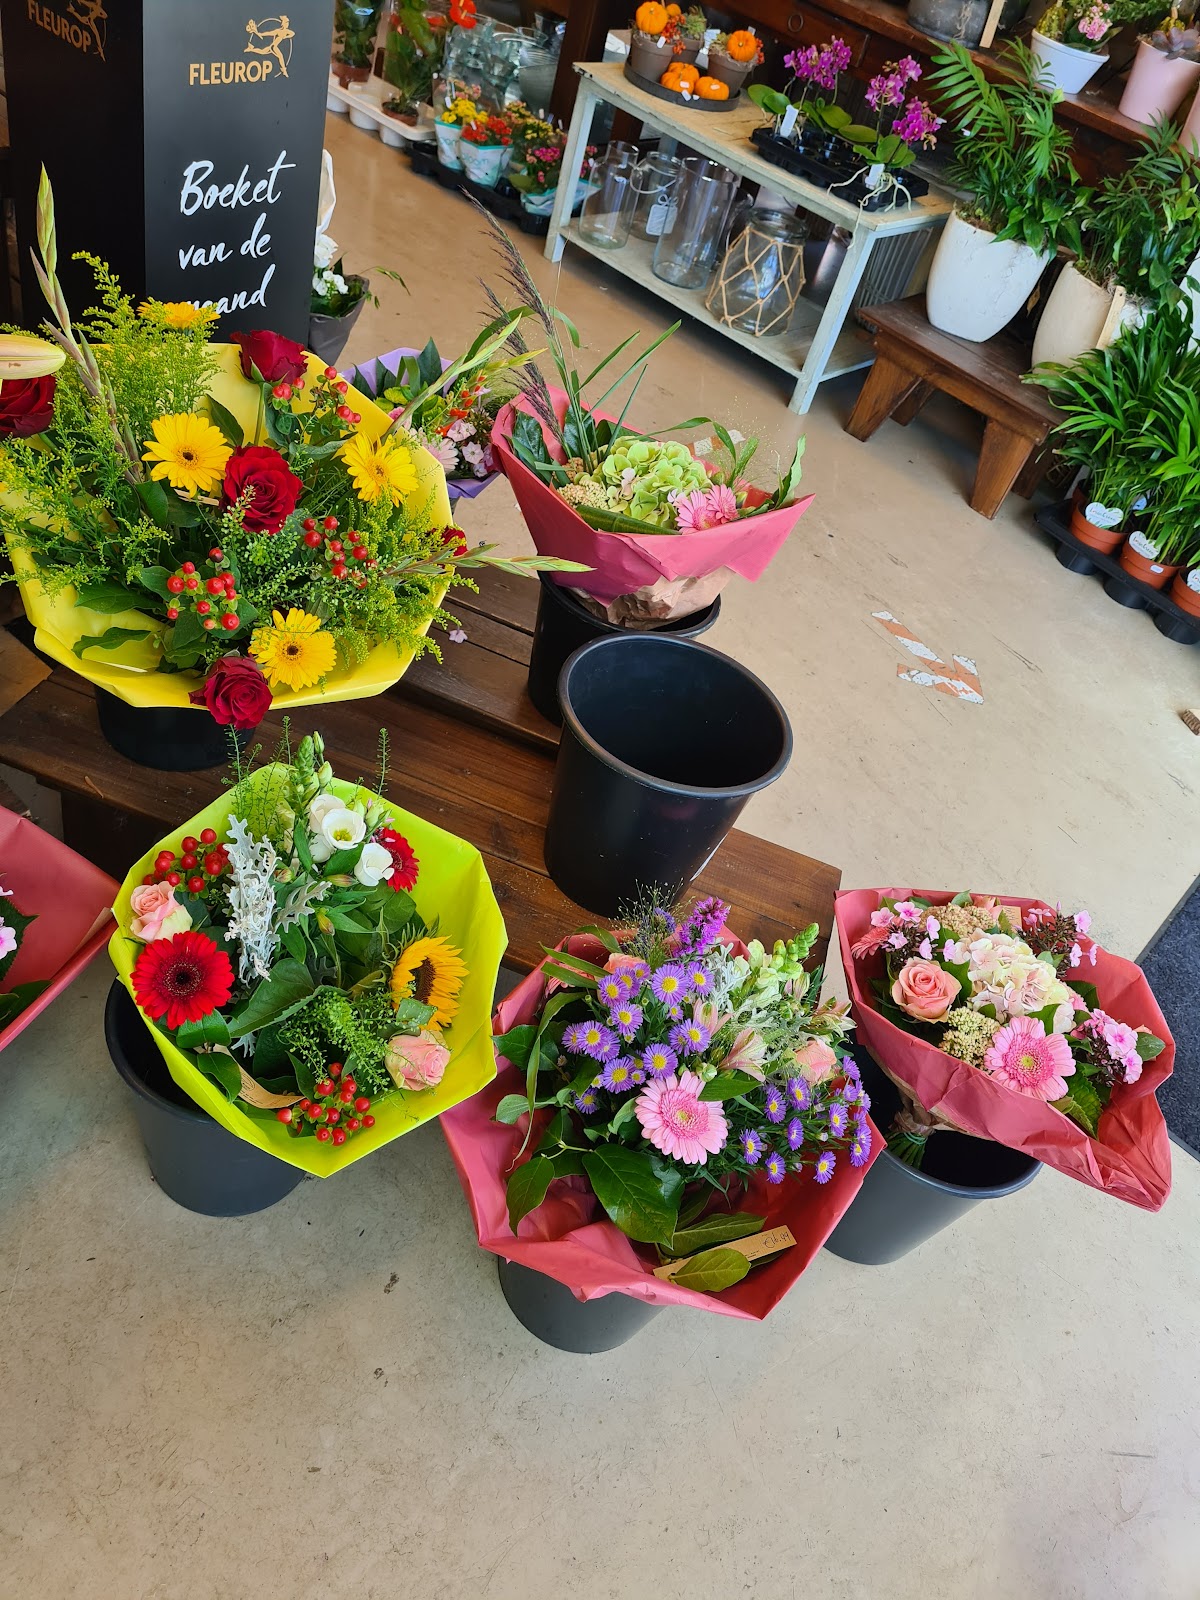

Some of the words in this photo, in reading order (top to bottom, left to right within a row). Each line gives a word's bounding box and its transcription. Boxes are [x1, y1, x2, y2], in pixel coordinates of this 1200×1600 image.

[27, 0, 92, 53] FLEUROP
[189, 60, 274, 86] FLEUROP
[180, 150, 297, 217] Boeket
[178, 247, 235, 270] van
[240, 212, 272, 258] de
